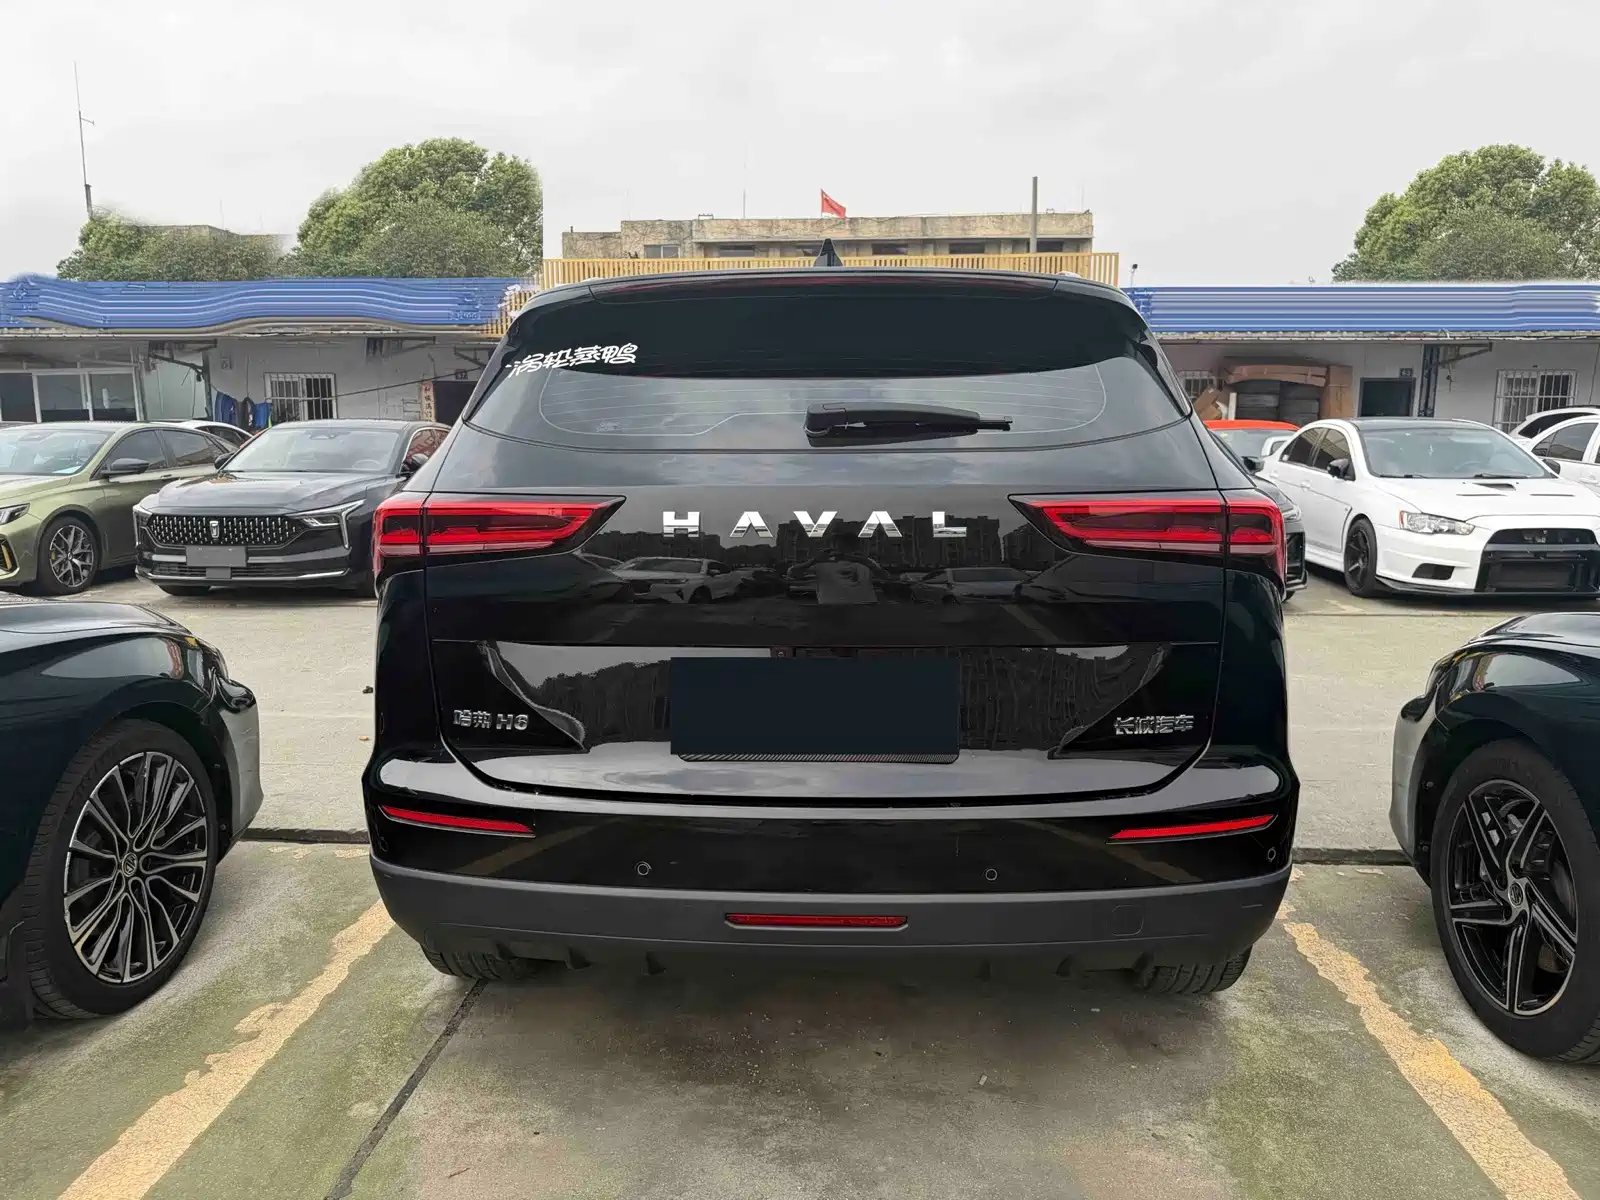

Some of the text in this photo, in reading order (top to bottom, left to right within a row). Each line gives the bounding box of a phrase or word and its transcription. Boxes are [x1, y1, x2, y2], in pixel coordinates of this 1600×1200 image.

[662, 510, 968, 538] HAVAL
[1113, 714, 1195, 735] 长城汽车
